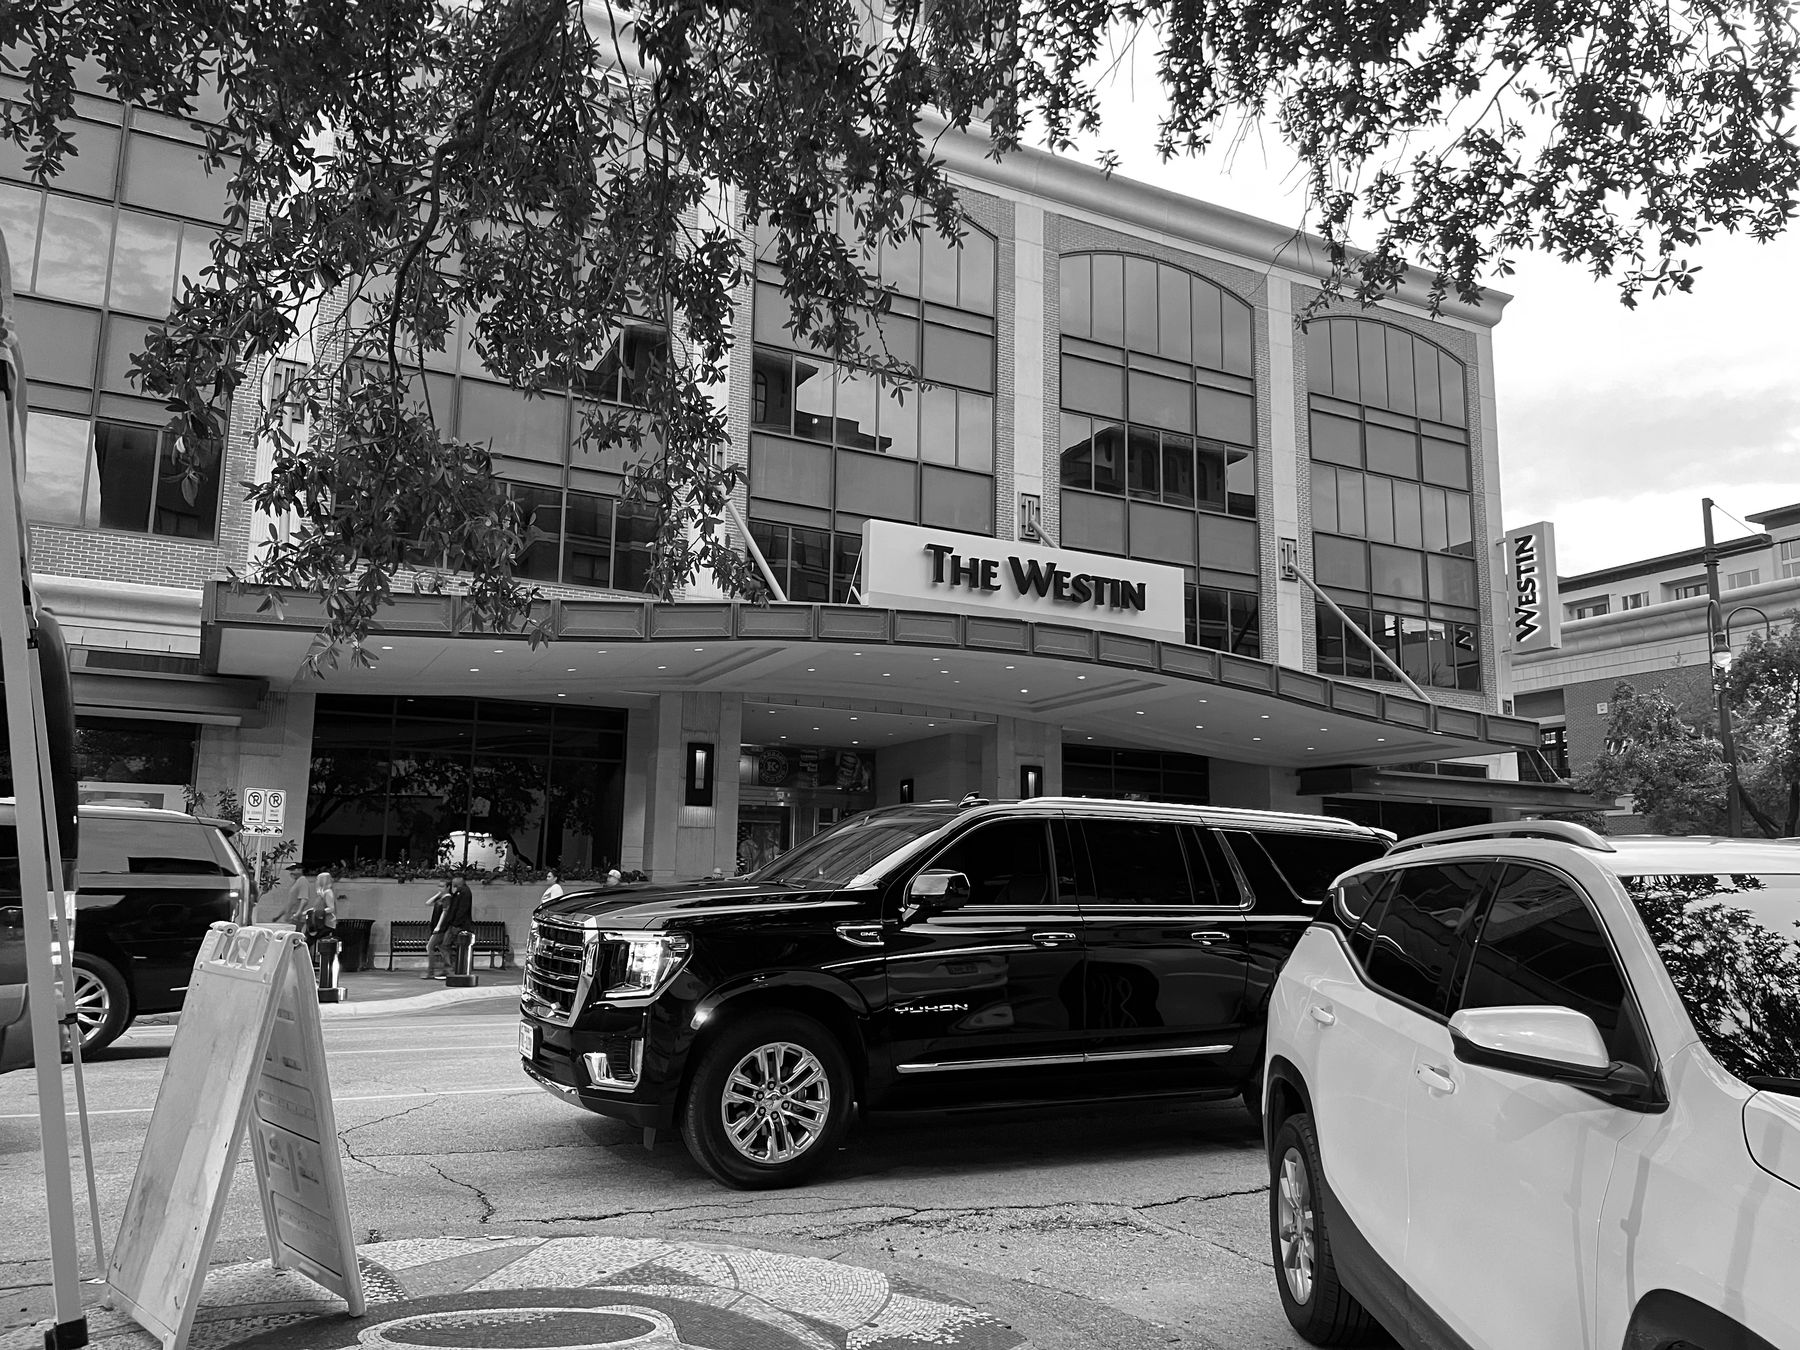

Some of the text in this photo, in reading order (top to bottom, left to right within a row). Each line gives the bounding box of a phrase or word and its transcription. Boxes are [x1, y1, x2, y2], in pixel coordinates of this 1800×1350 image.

[923, 543, 1147, 612] THE WESTIN
[1514, 534, 1539, 642] WESTIN
[894, 1003, 969, 1014] YUKON
